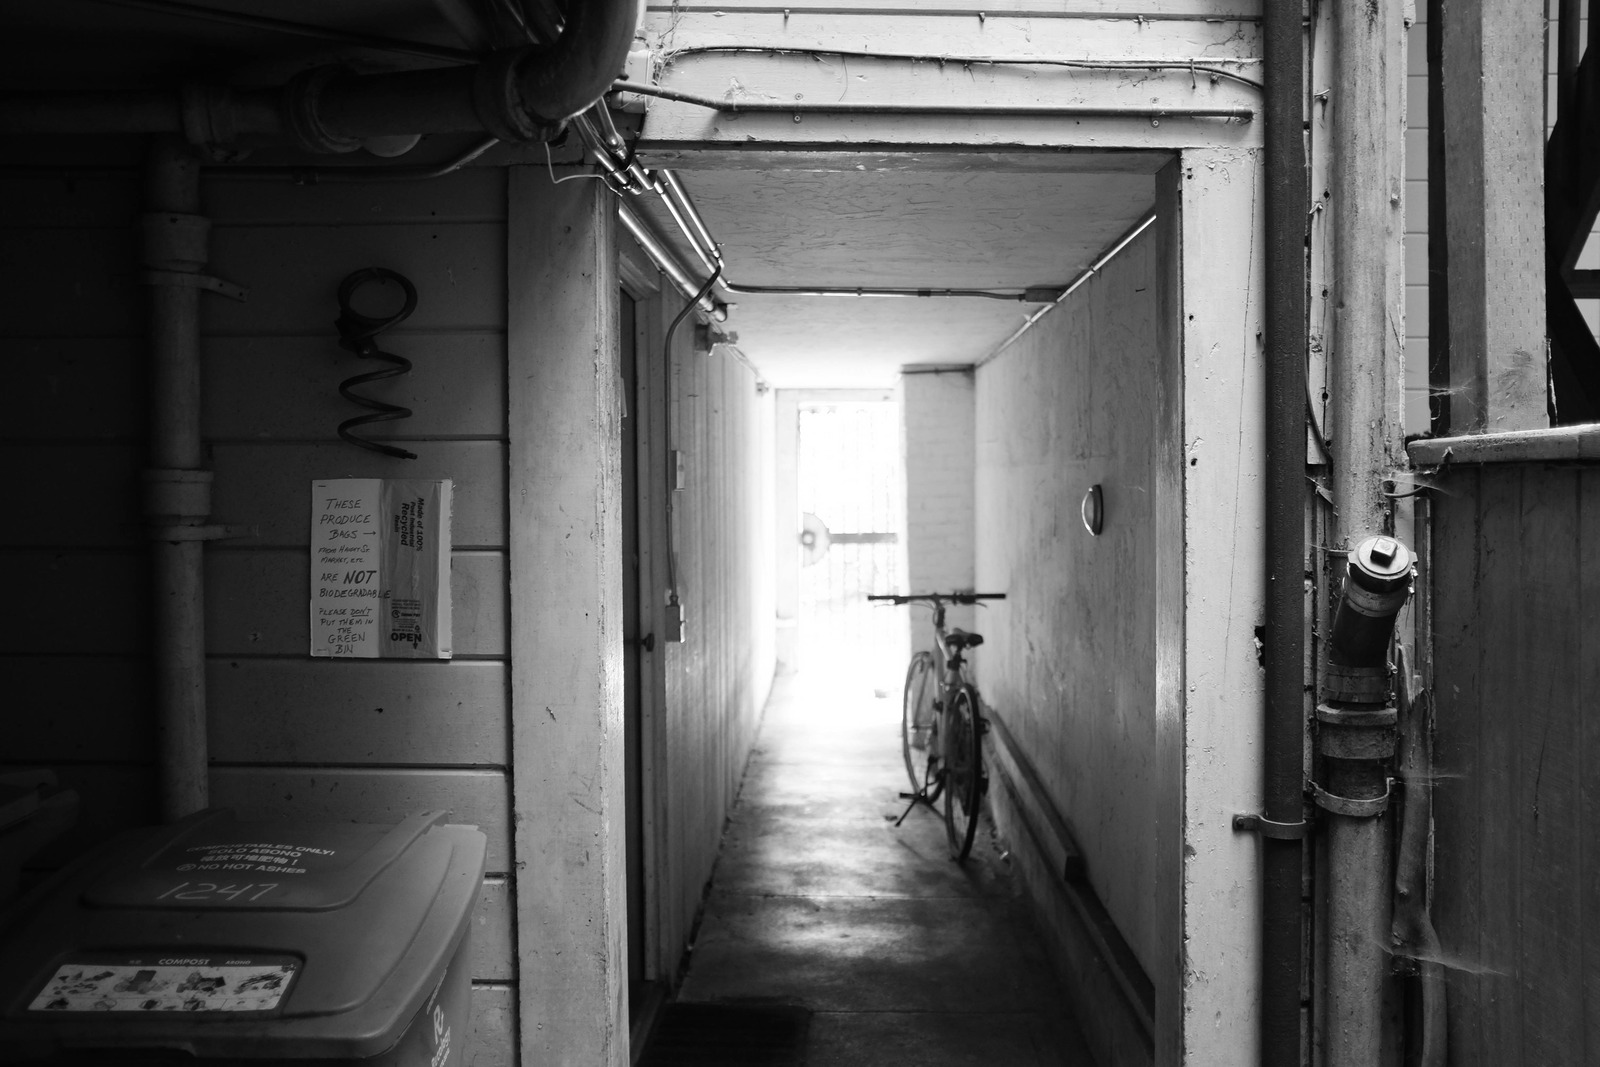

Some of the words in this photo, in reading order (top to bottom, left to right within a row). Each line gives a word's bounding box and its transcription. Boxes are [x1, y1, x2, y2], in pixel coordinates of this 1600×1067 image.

[326, 498, 362, 510] THESE
[417, 497, 425, 519] Made
[320, 514, 371, 525] PRODUCE
[400, 502, 410, 546] Recycled
[417, 521, 424, 530] of
[328, 529, 358, 540] BAGS
[416, 530, 424, 552] 100%
[320, 573, 339, 583] ARE
[343, 570, 377, 584] NOT
[319, 588, 392, 599] BIODEGRADABLE
[318, 607, 348, 616] PLEASE
[350, 606, 373, 616] DON'T
[320, 618, 336, 626] PUT
[338, 618, 363, 626] THEM
[337, 626, 352, 634] THE
[328, 632, 366, 644] GREEN
[391, 632, 422, 643] OPEN
[335, 644, 354, 654] BIN
[250, 848, 302, 857] ABONO
[295, 846, 336, 856] ONLY!
[222, 863, 254, 871] HOT
[255, 865, 307, 874] ASHES
[156, 882, 279, 901] 1247
[158, 958, 211, 966] COMPOST
